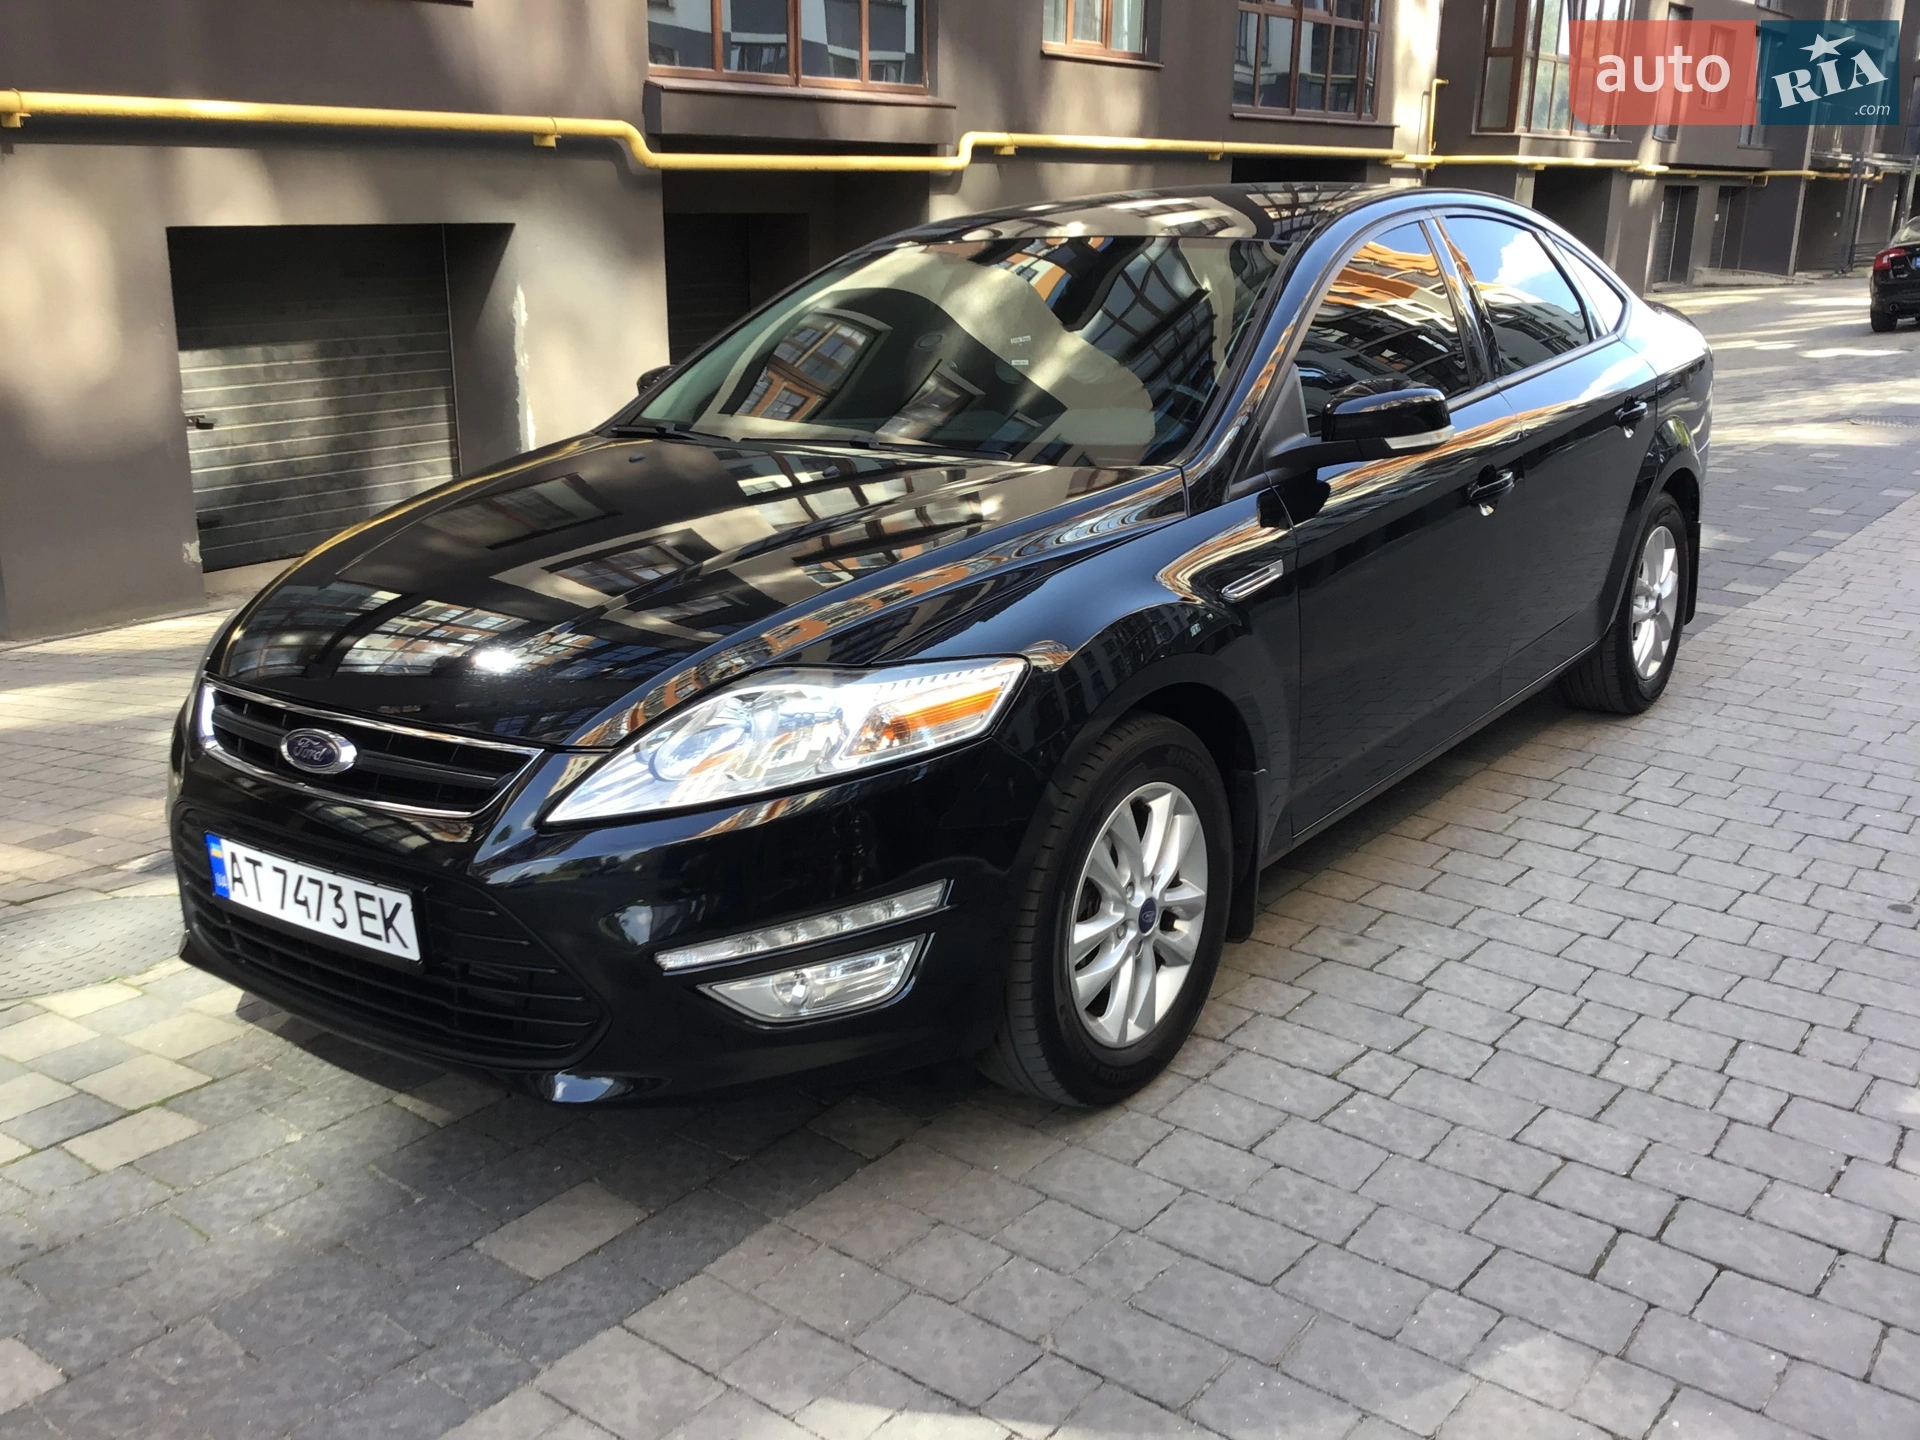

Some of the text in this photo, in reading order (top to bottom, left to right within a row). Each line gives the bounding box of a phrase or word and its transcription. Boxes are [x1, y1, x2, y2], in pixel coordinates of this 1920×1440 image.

[293, 737, 328, 762] Ford
[230, 851, 409, 949] AT 7473 EK
